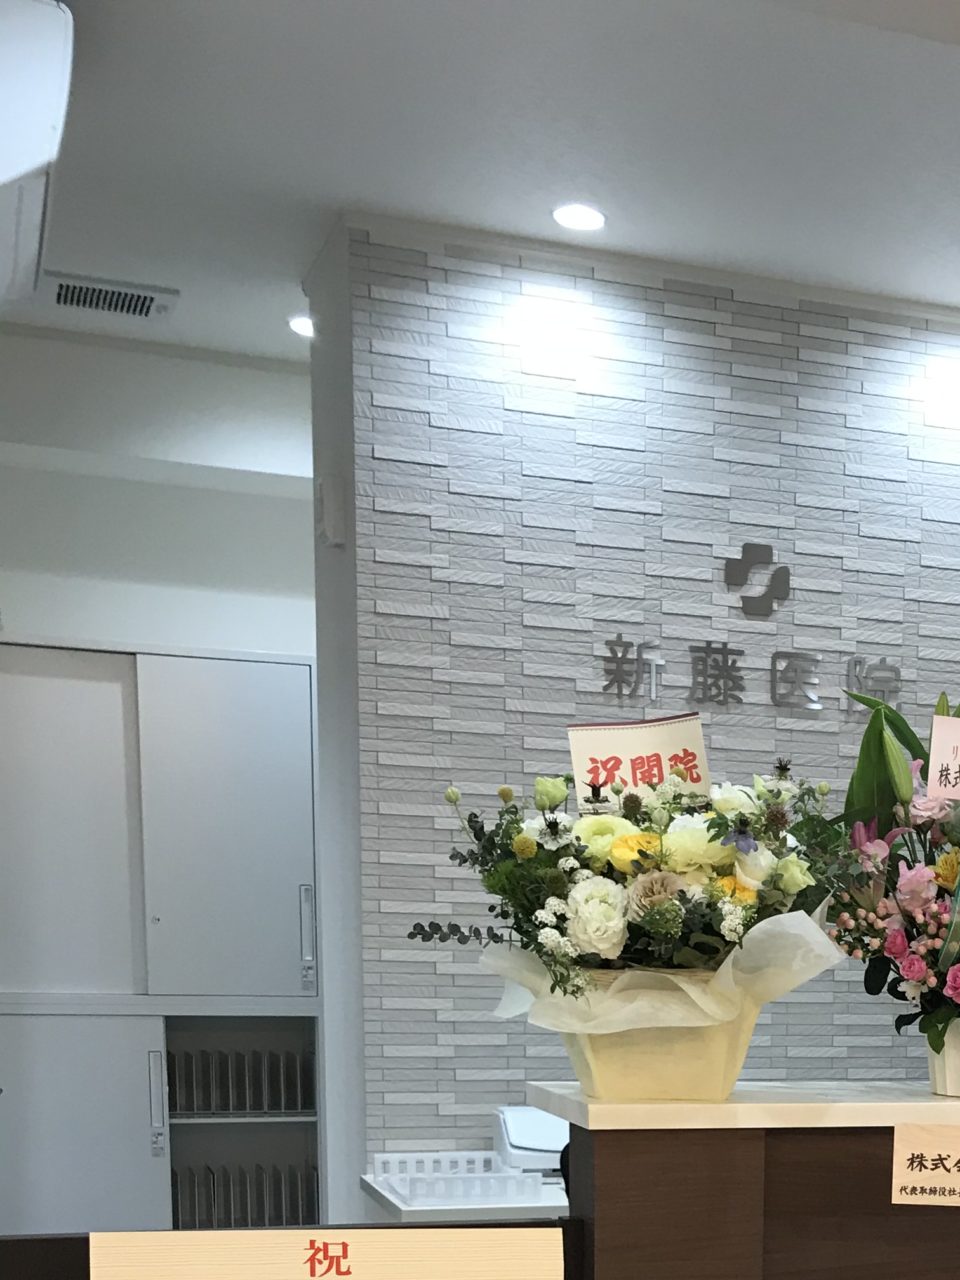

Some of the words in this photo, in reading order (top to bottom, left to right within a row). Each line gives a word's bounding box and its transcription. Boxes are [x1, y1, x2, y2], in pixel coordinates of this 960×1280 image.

[602, 633, 902, 716] 新藤医院
[586, 748, 702, 787] 祝開院
[303, 1239, 352, 1278] 祝
